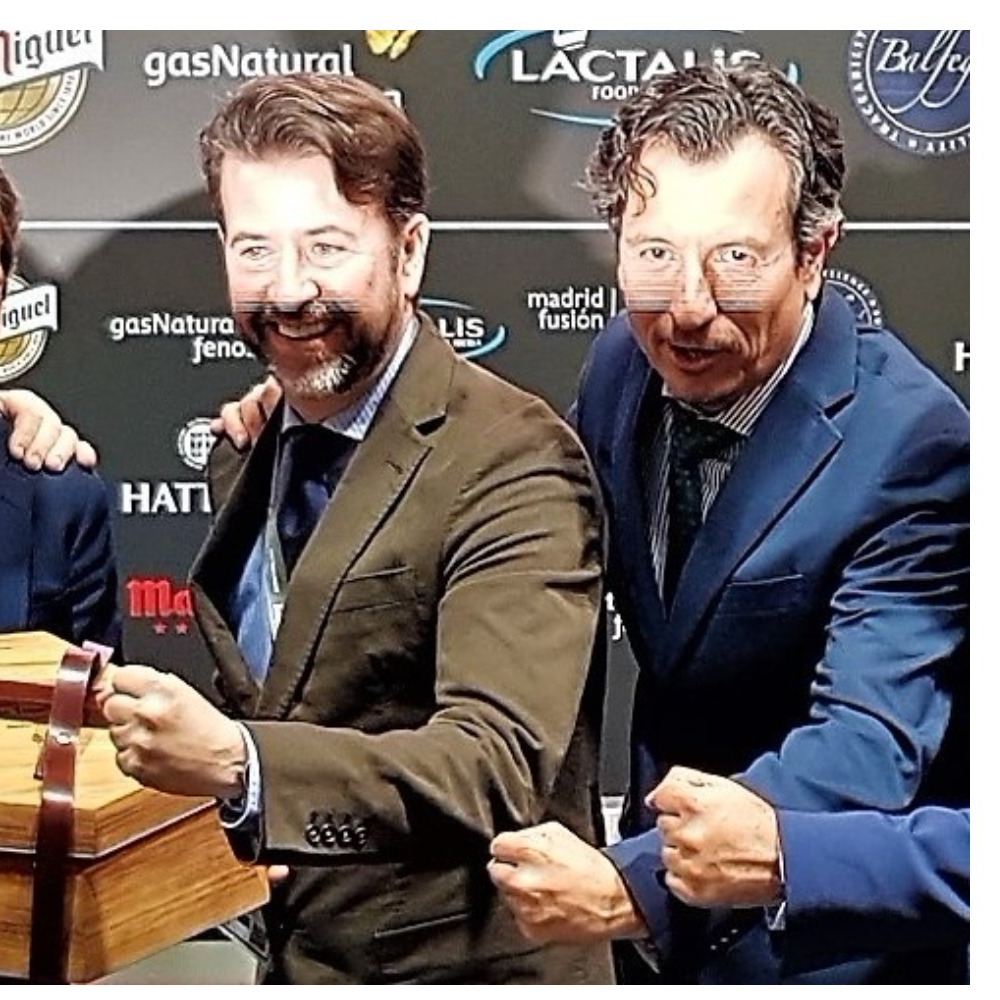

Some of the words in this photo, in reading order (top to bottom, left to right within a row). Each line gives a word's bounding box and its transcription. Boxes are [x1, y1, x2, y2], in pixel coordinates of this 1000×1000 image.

[144, 44, 353, 87] gasNatural
[528, 286, 604, 308] madrid
[538, 307, 604, 329] fusión
[191, 336, 253, 363] feno
